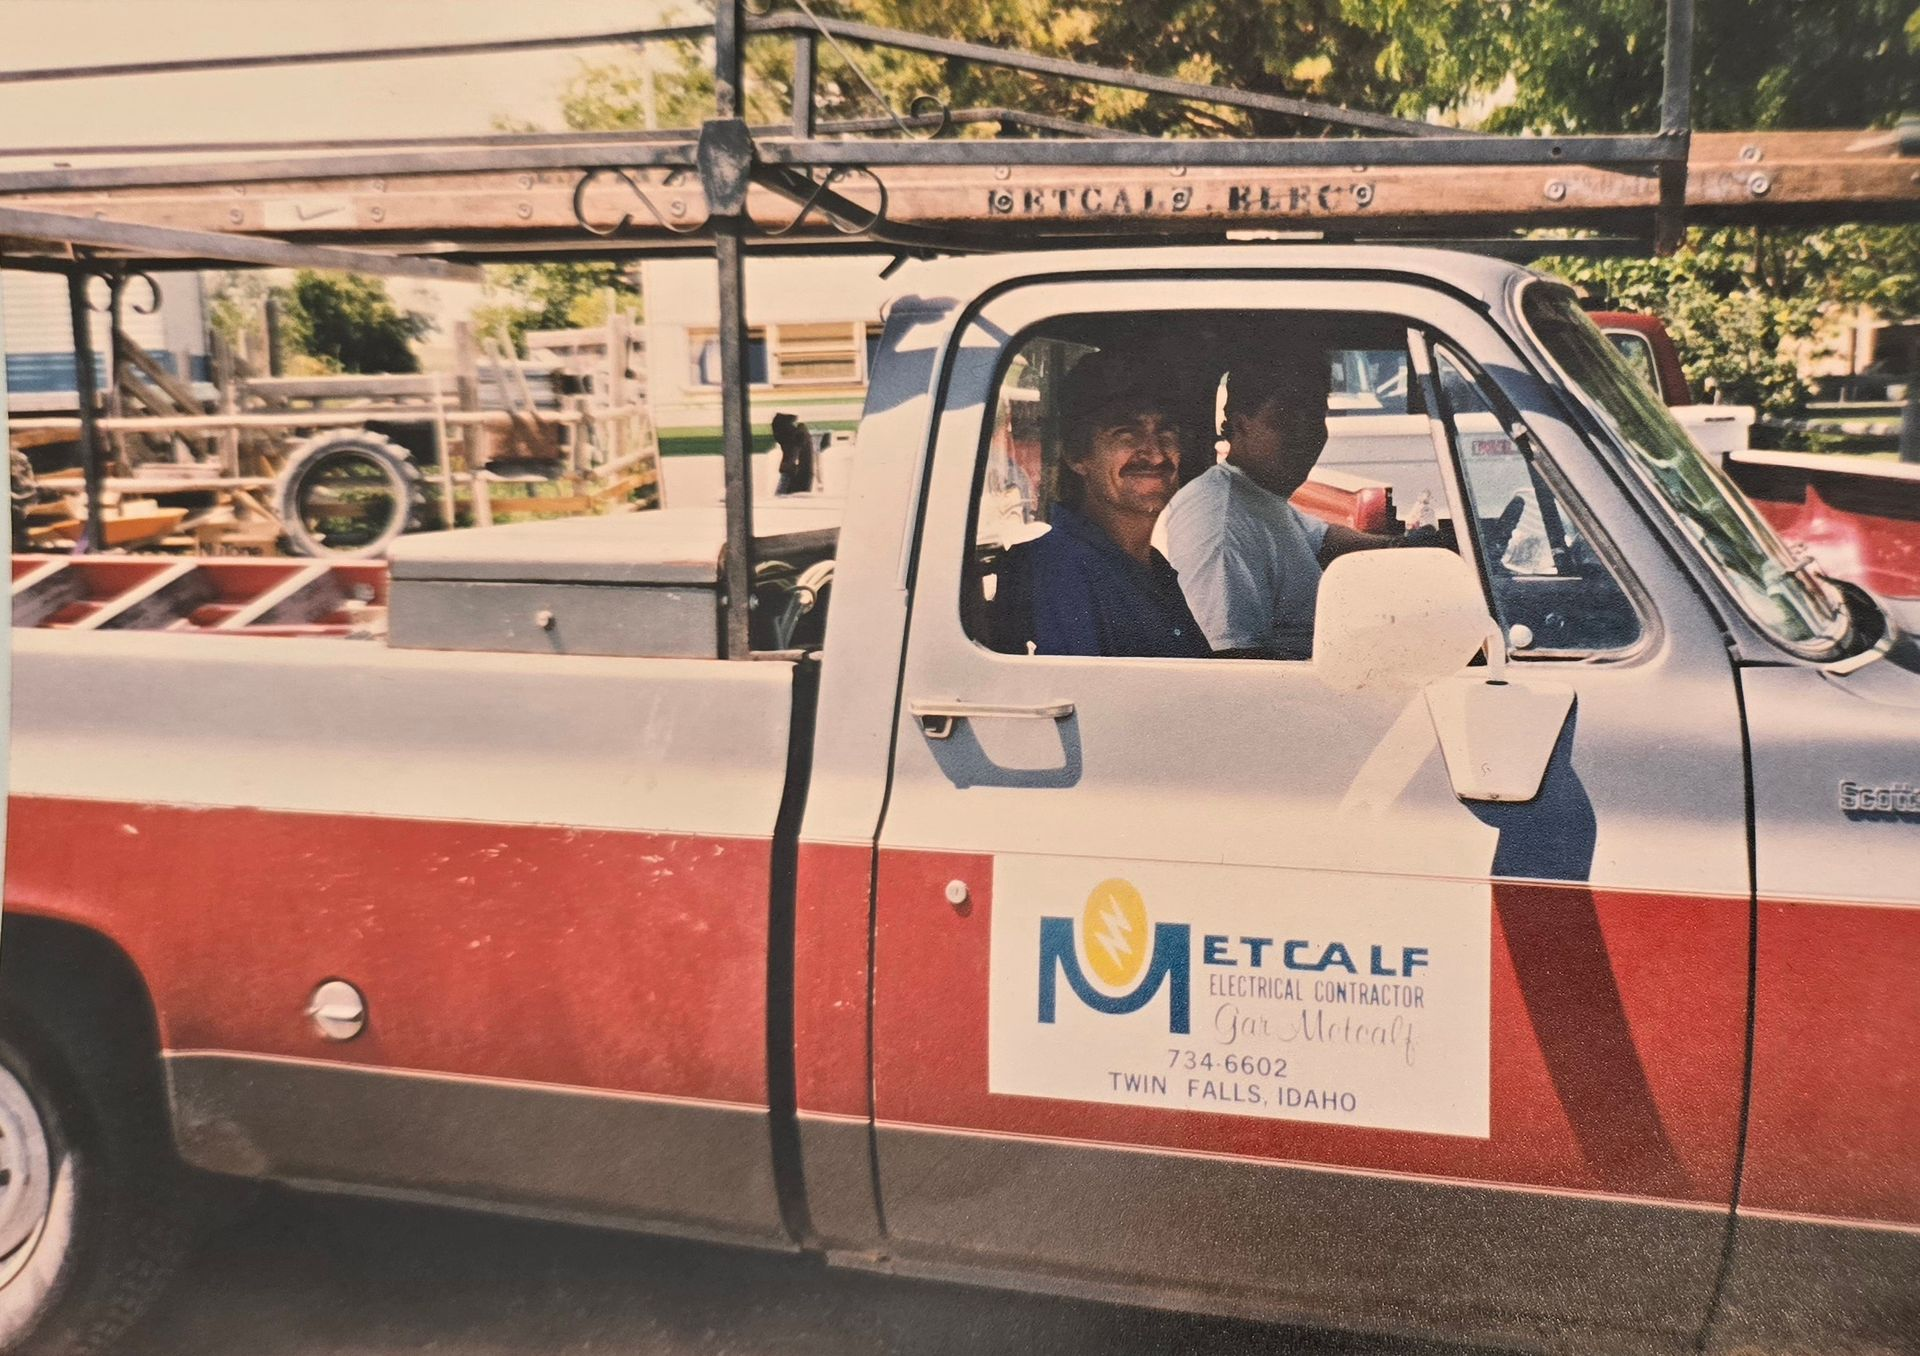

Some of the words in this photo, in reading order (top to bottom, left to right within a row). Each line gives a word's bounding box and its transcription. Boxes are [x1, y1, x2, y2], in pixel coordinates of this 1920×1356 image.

[1038, 916, 1429, 1035] METCALF
[1209, 974, 1304, 1001] ELECTRICAL
[1314, 980, 1425, 1009] CONTRACTOR
[1109, 1072, 1167, 1095] TWIN
[1187, 1079, 1269, 1106] FALLS,
[1278, 1087, 1357, 1113] IDAHO
